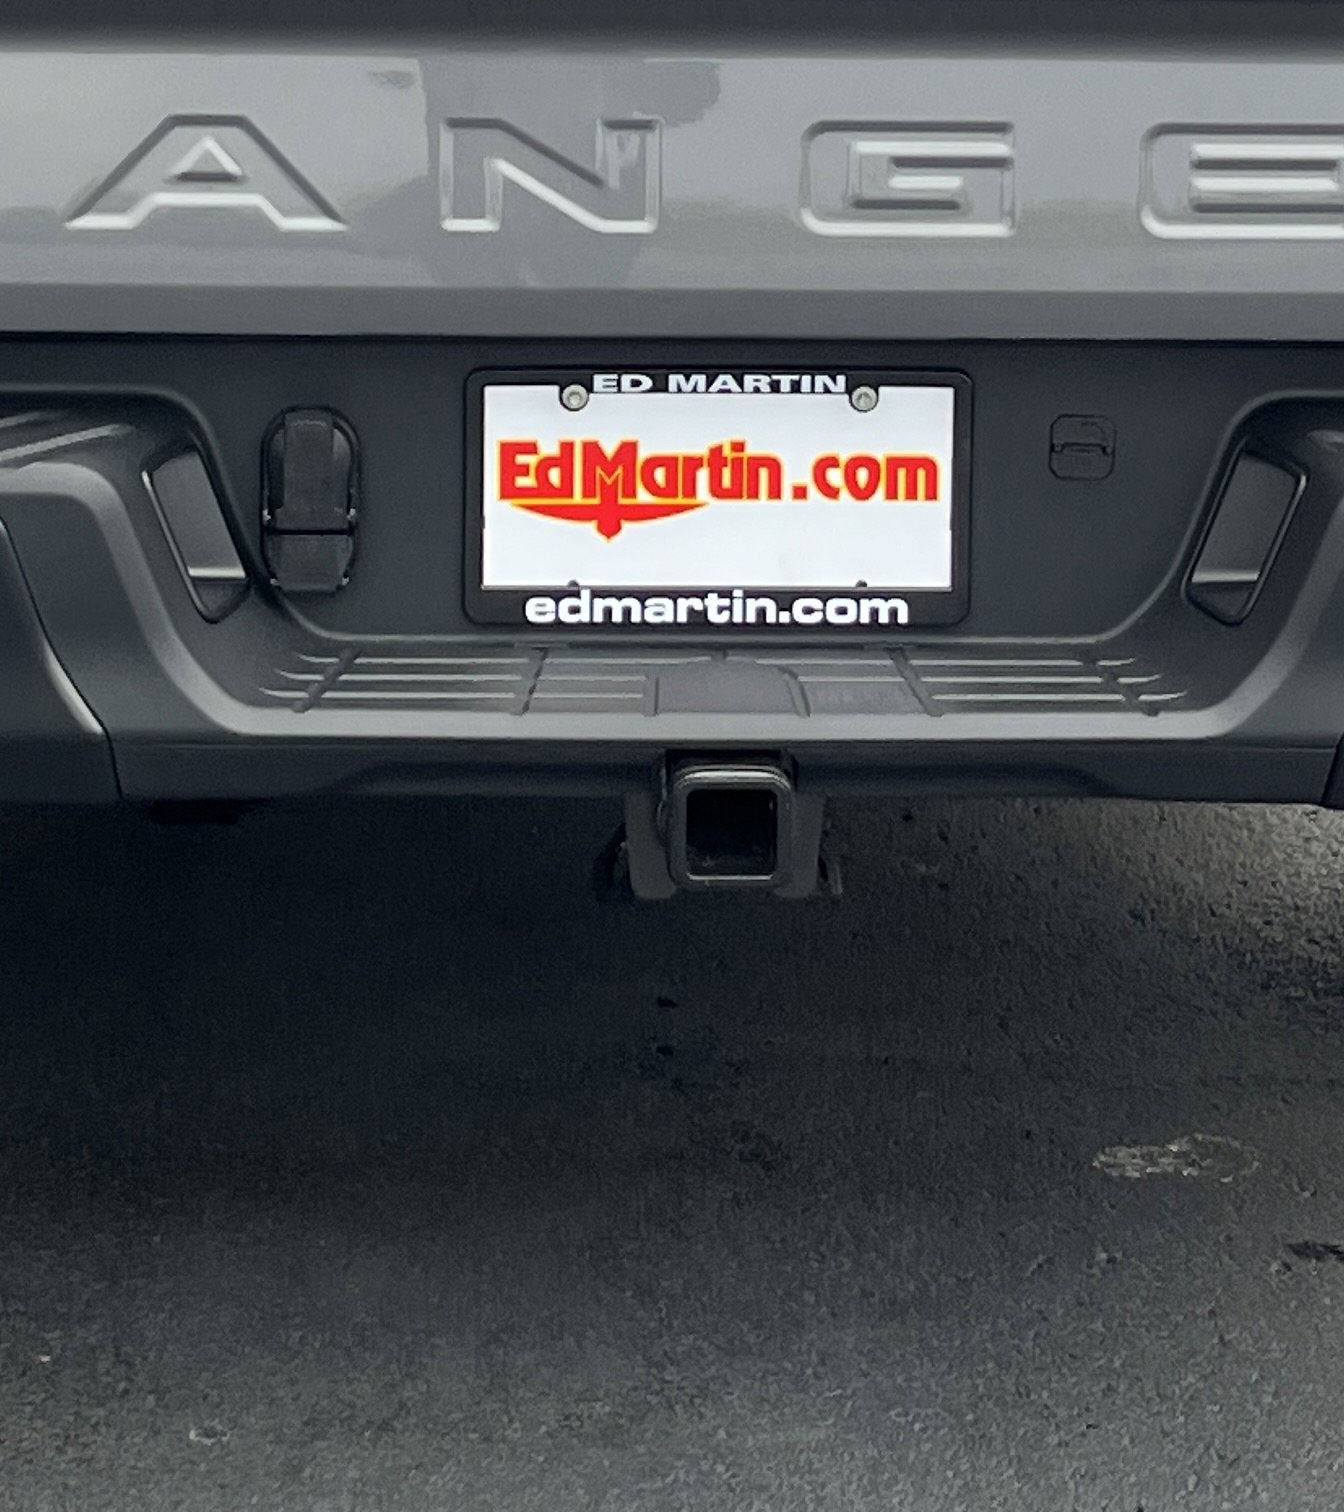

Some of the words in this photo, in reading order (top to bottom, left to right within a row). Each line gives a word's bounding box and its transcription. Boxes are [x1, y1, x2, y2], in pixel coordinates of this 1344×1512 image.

[592, 374, 654, 394] ED
[667, 374, 848, 394] MARTIN
[524, 589, 910, 625] edmartin.com
